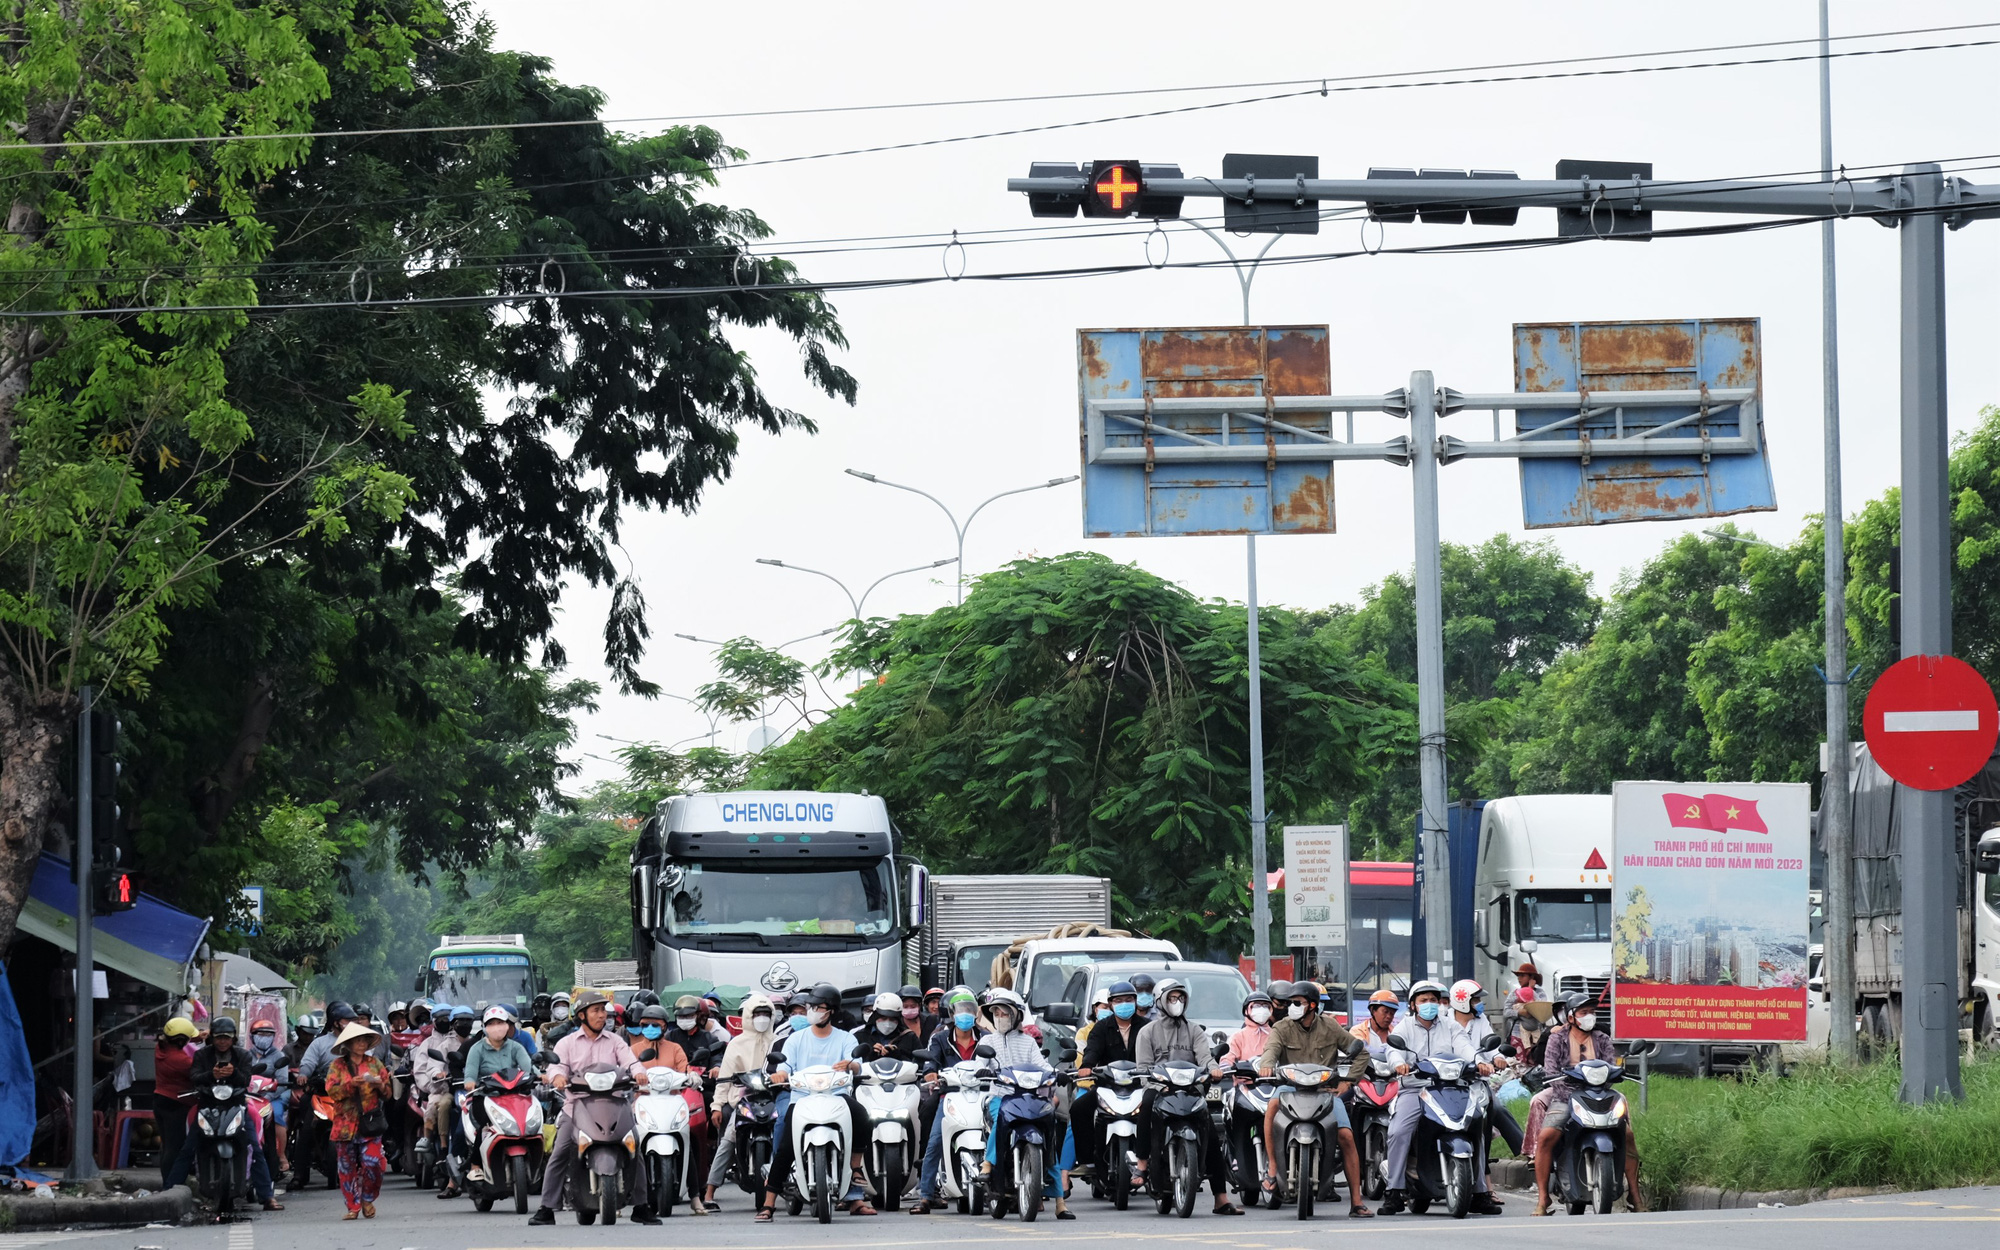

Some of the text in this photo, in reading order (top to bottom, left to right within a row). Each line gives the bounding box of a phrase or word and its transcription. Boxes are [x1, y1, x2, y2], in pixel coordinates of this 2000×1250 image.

[723, 803, 833, 822] CHENGLONG
[1654, 838, 1773, 854] THÀNH PHỐ HỒ CHÍ MINH
[1623, 854, 1803, 870] HÂN HOAN CHÀO ĐÓN NĂM MỚI 2023
[436, 958, 447, 970] 102
[1615, 996, 1632, 1005] MỪNG
[1632, 996, 1646, 1005] NĂM
[1646, 996, 1657, 1006] MỚI
[1658, 997, 1673, 1006] 2023
[1674, 997, 1692, 1006] QUYẾT
[1693, 997, 1706, 1007] TÂM
[1706, 998, 1718, 1007] XÂY
[1719, 999, 1735, 1008] DỰNG
[1736, 998, 1754, 1008] THÀNH
[1755, 998, 1768, 1008] PHỐ
[1776, 999, 1787, 1009] CHÍ
[1787, 1000, 1803, 1009] MINH
[1626, 1008, 1635, 1017] CÓ
[1635, 1007, 1650, 1017] CHẤT
[1651, 1008, 1669, 1019] LƯỢNG
[1670, 1008, 1686, 1018] SỐNG
[1700, 1010, 1711, 1019] VĂN
[1730, 1010, 1743, 1020] HIỆN
[1757, 1011, 1774, 1020] NGHĨA
[1665, 1019, 1752, 1031] TRỞ THÀNH ĐÔ THỊ THÔNG MINH
